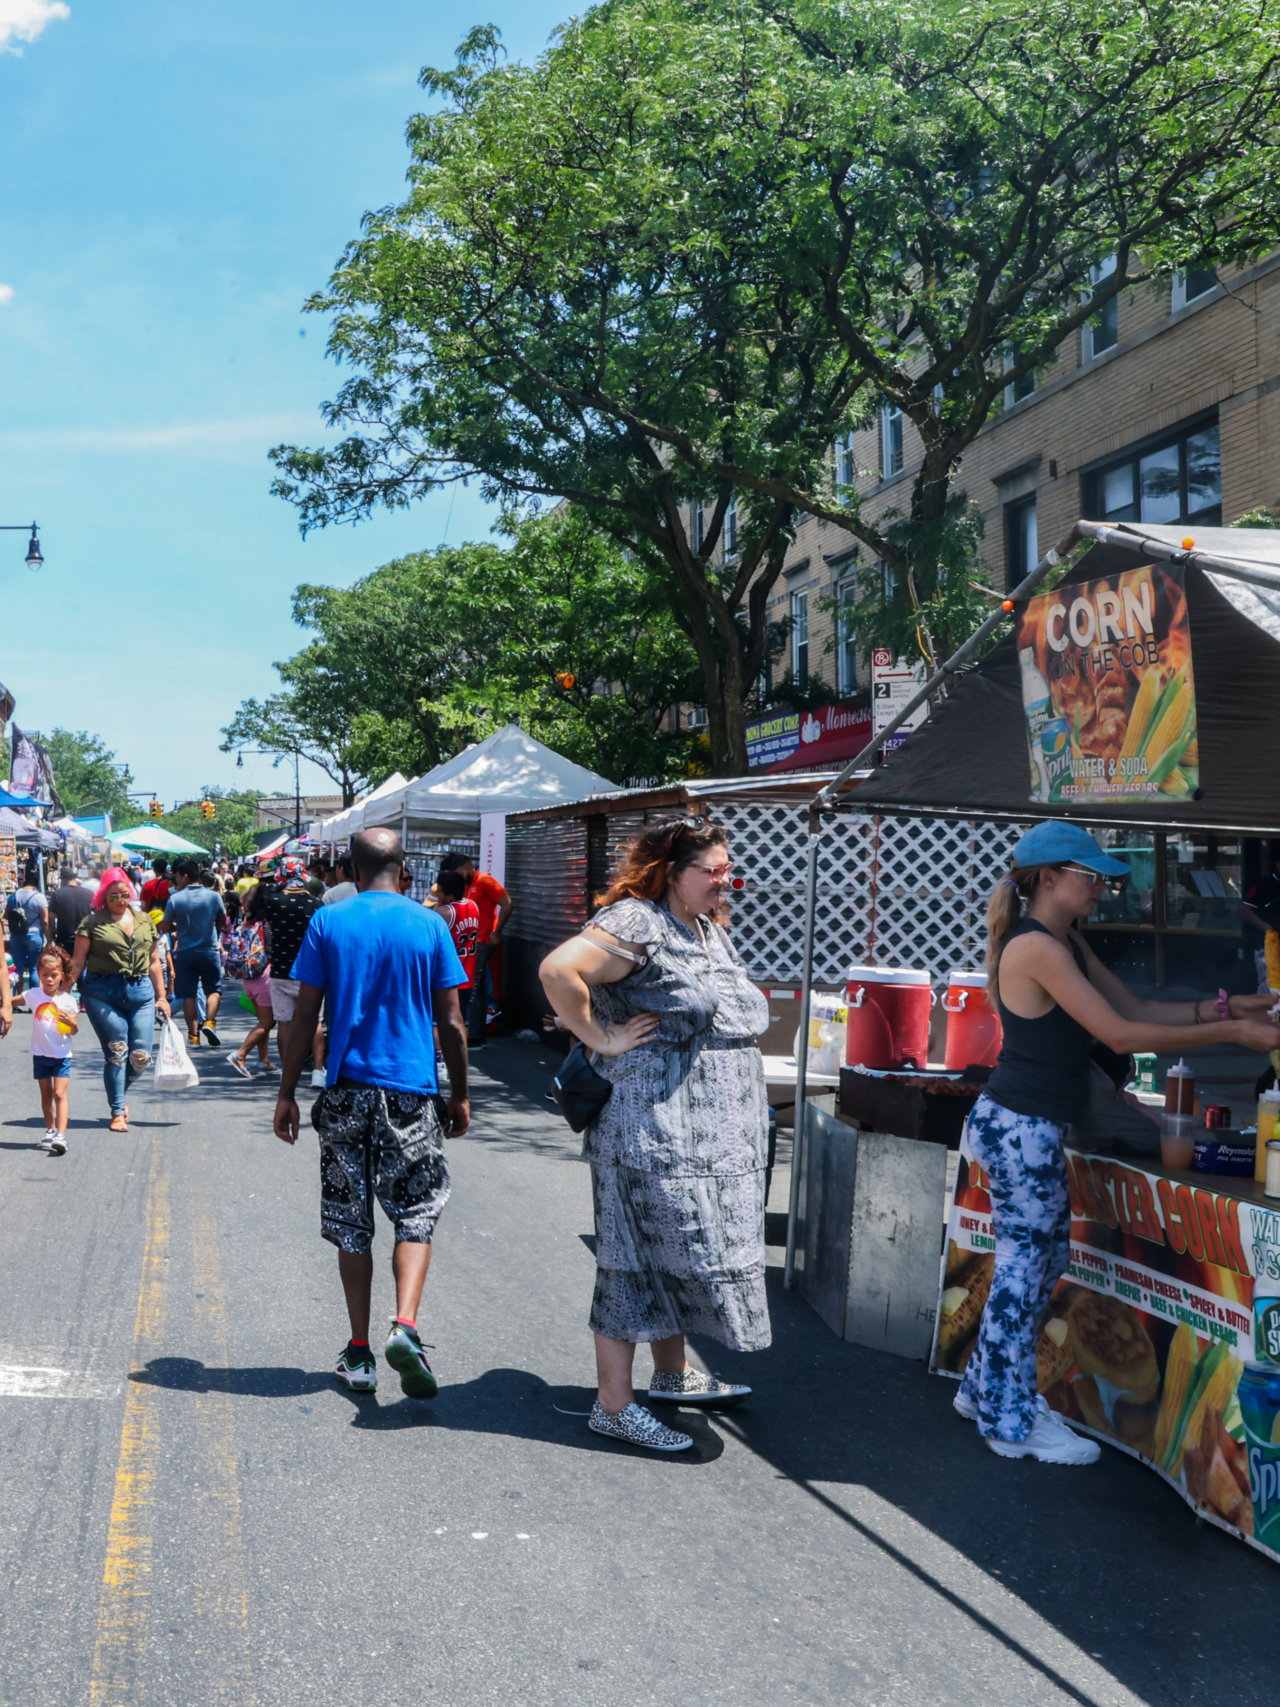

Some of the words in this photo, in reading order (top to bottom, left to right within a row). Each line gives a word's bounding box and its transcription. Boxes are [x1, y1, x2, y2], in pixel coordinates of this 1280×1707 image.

[1046, 581, 1154, 652] CORN
[1051, 655, 1076, 679] ON
[1081, 649, 1114, 674] THE
[1120, 639, 1160, 669] COB
[877, 683, 887, 698] 2
[1070, 758, 1106, 778] WATER
[1108, 758, 1117, 776] &
[1119, 757, 1148, 776] SODA
[457, 930, 477, 957] 23
[1218, 1144, 1256, 1155] Reynold
[982, 1222, 988, 1233] &
[1156, 1178, 1252, 1278] CORN
[1252, 1244, 1264, 1276] &
[1077, 1266, 1105, 1288] PEPPER
[1150, 1294, 1168, 1315] BEEF
[1176, 1306, 1208, 1333] CHICKEN
[1081, 1252, 1108, 1273] PEPPER
[1153, 1277, 1183, 1304] CHEESE
[1217, 1308, 1225, 1322] &
